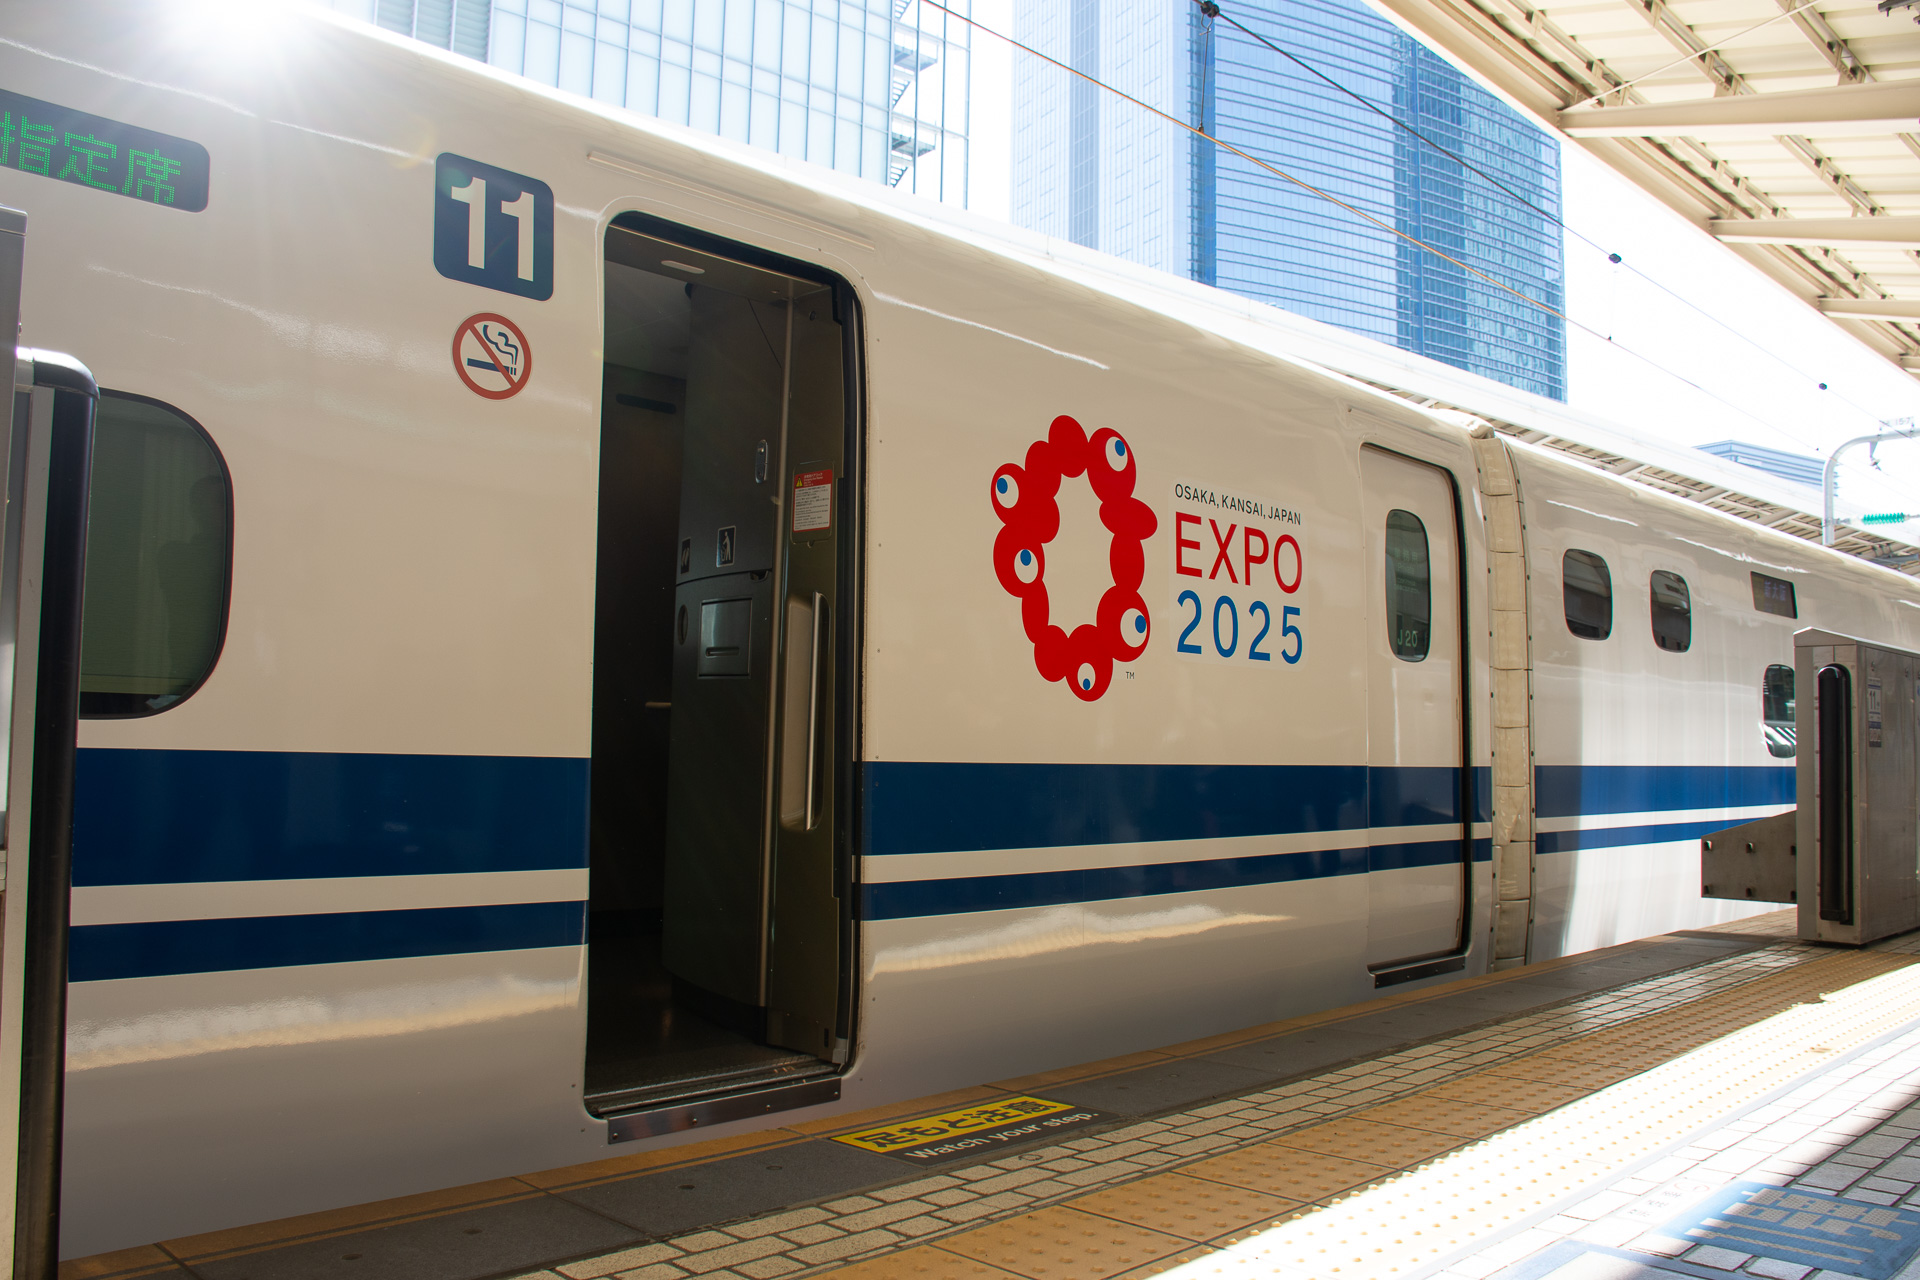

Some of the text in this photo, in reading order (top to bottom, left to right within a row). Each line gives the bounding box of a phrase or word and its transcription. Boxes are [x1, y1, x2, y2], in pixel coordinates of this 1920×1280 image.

[0, 111, 181, 204] 指定席
[451, 176, 534, 282] 11
[1175, 483, 1301, 525] OSAKA, KANSAI, JAPAN
[1175, 511, 1302, 594] EXPO
[1177, 589, 1303, 664] 2025
[1125, 671, 1135, 680] TM
[854, 1100, 1057, 1148] 足もと注意
[904, 1113, 1099, 1159] Watch your step.
